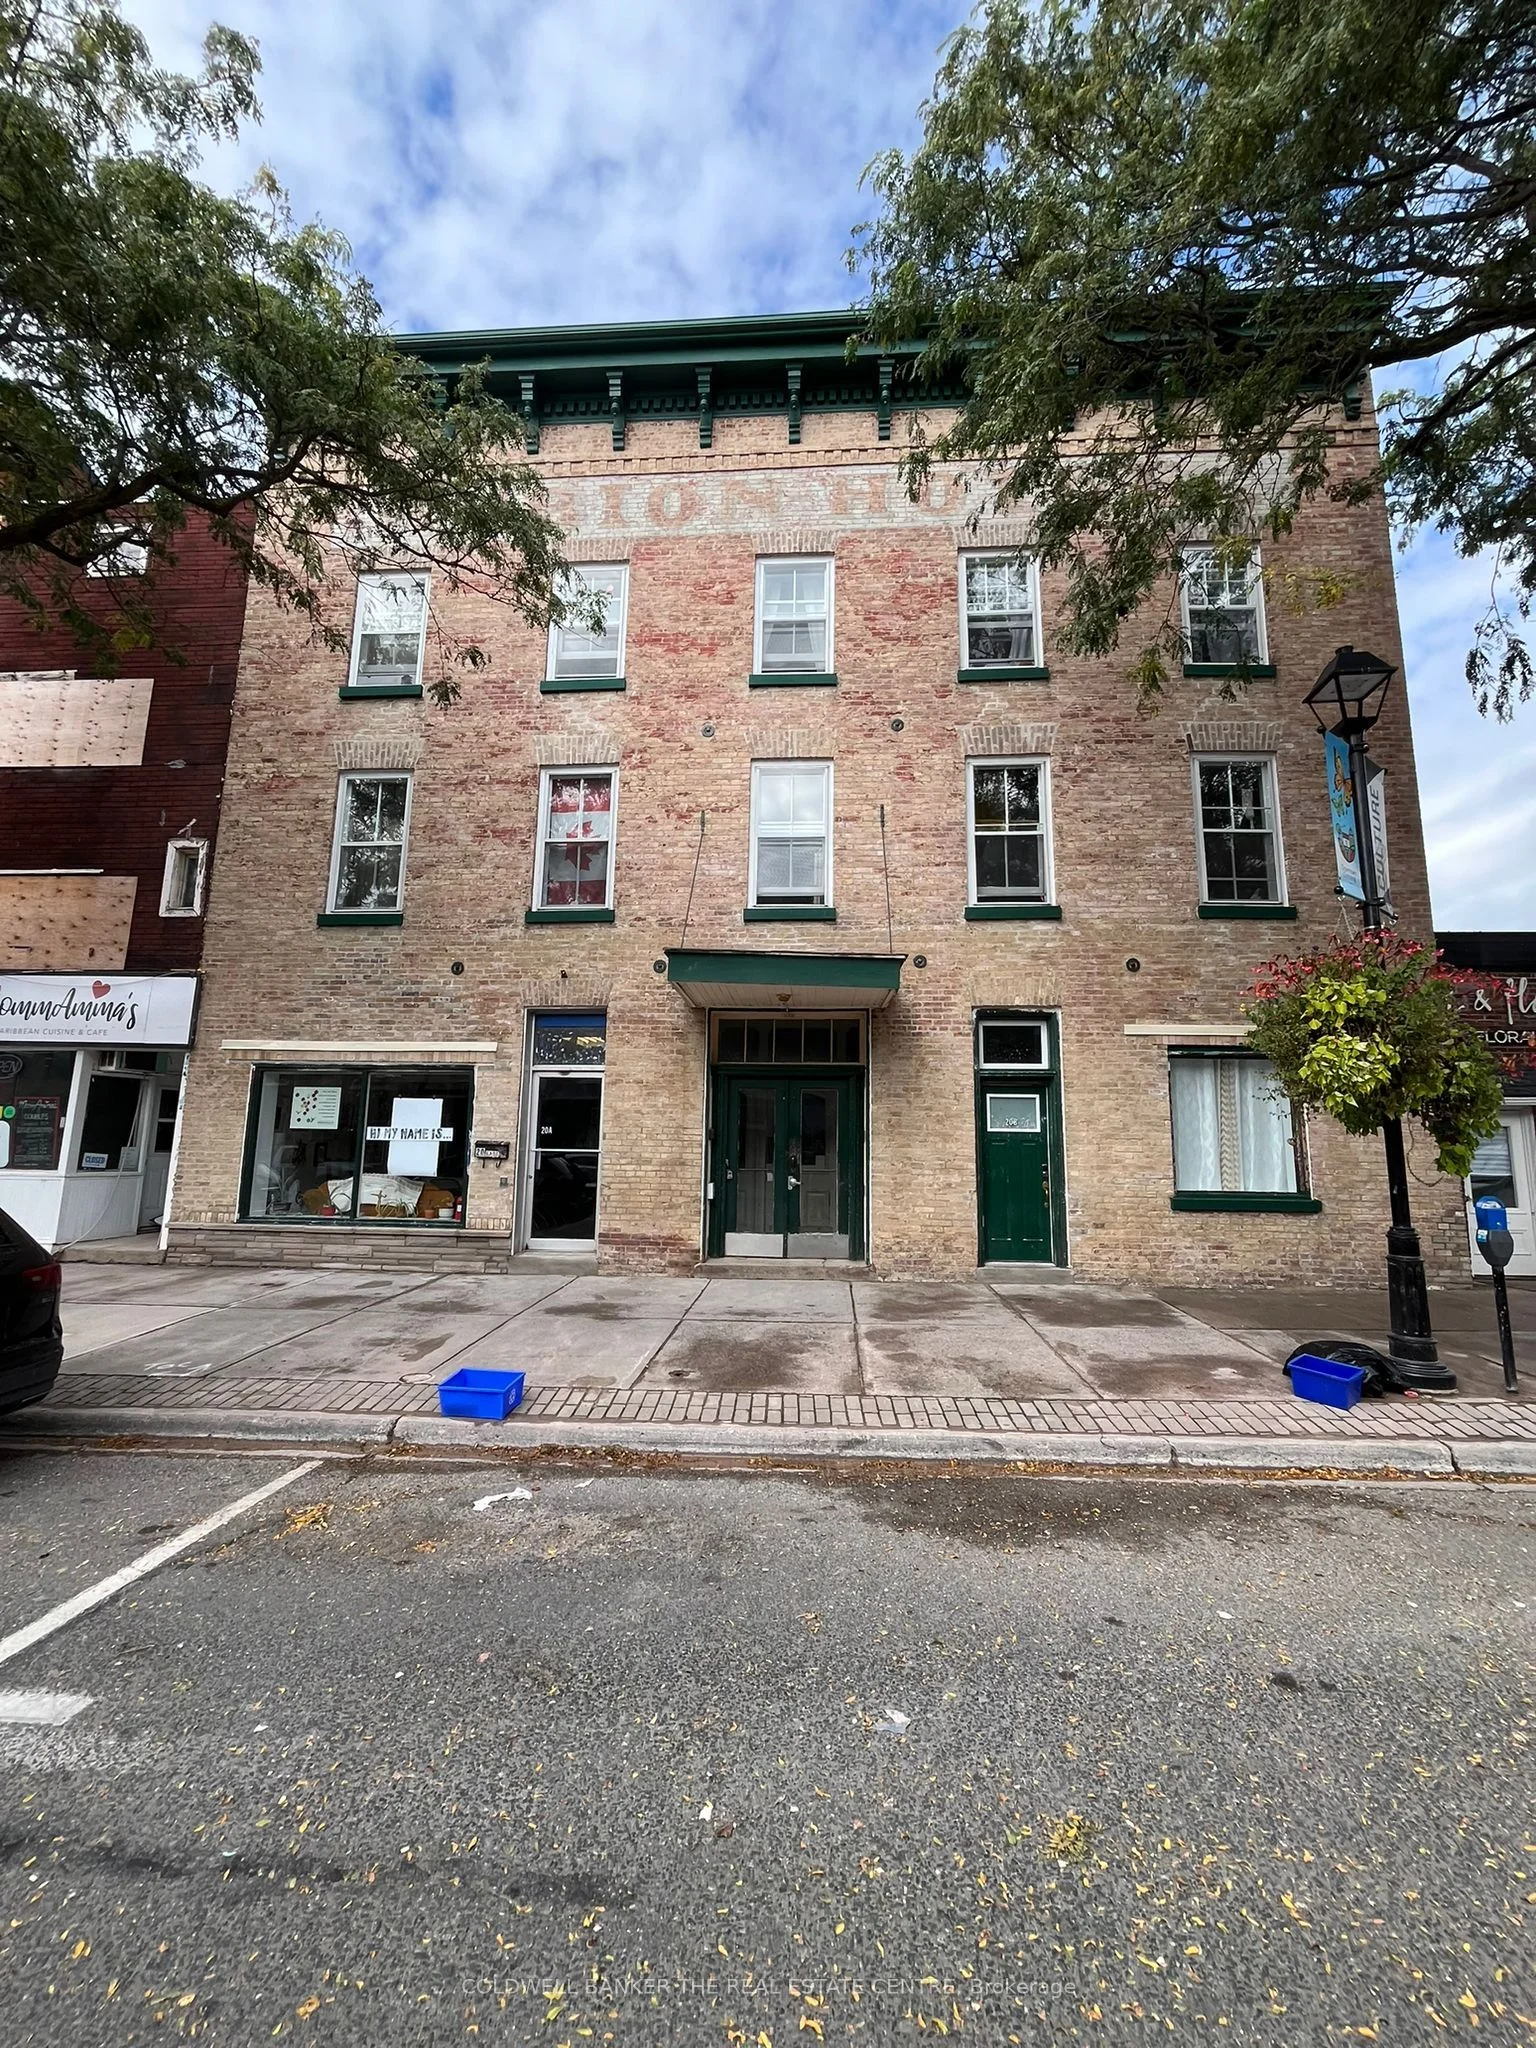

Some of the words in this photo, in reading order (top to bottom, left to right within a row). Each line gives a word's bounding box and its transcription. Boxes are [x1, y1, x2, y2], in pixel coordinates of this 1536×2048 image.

[1368, 784, 1388, 894] CULTURE
[0, 985, 138, 1030] ommAmma's
[0, 1027, 40, 1035] ARIBBEAN
[384, 1127, 398, 1139] MY
[400, 1128, 430, 1139] NAME
[541, 1126, 553, 1134] 20A
